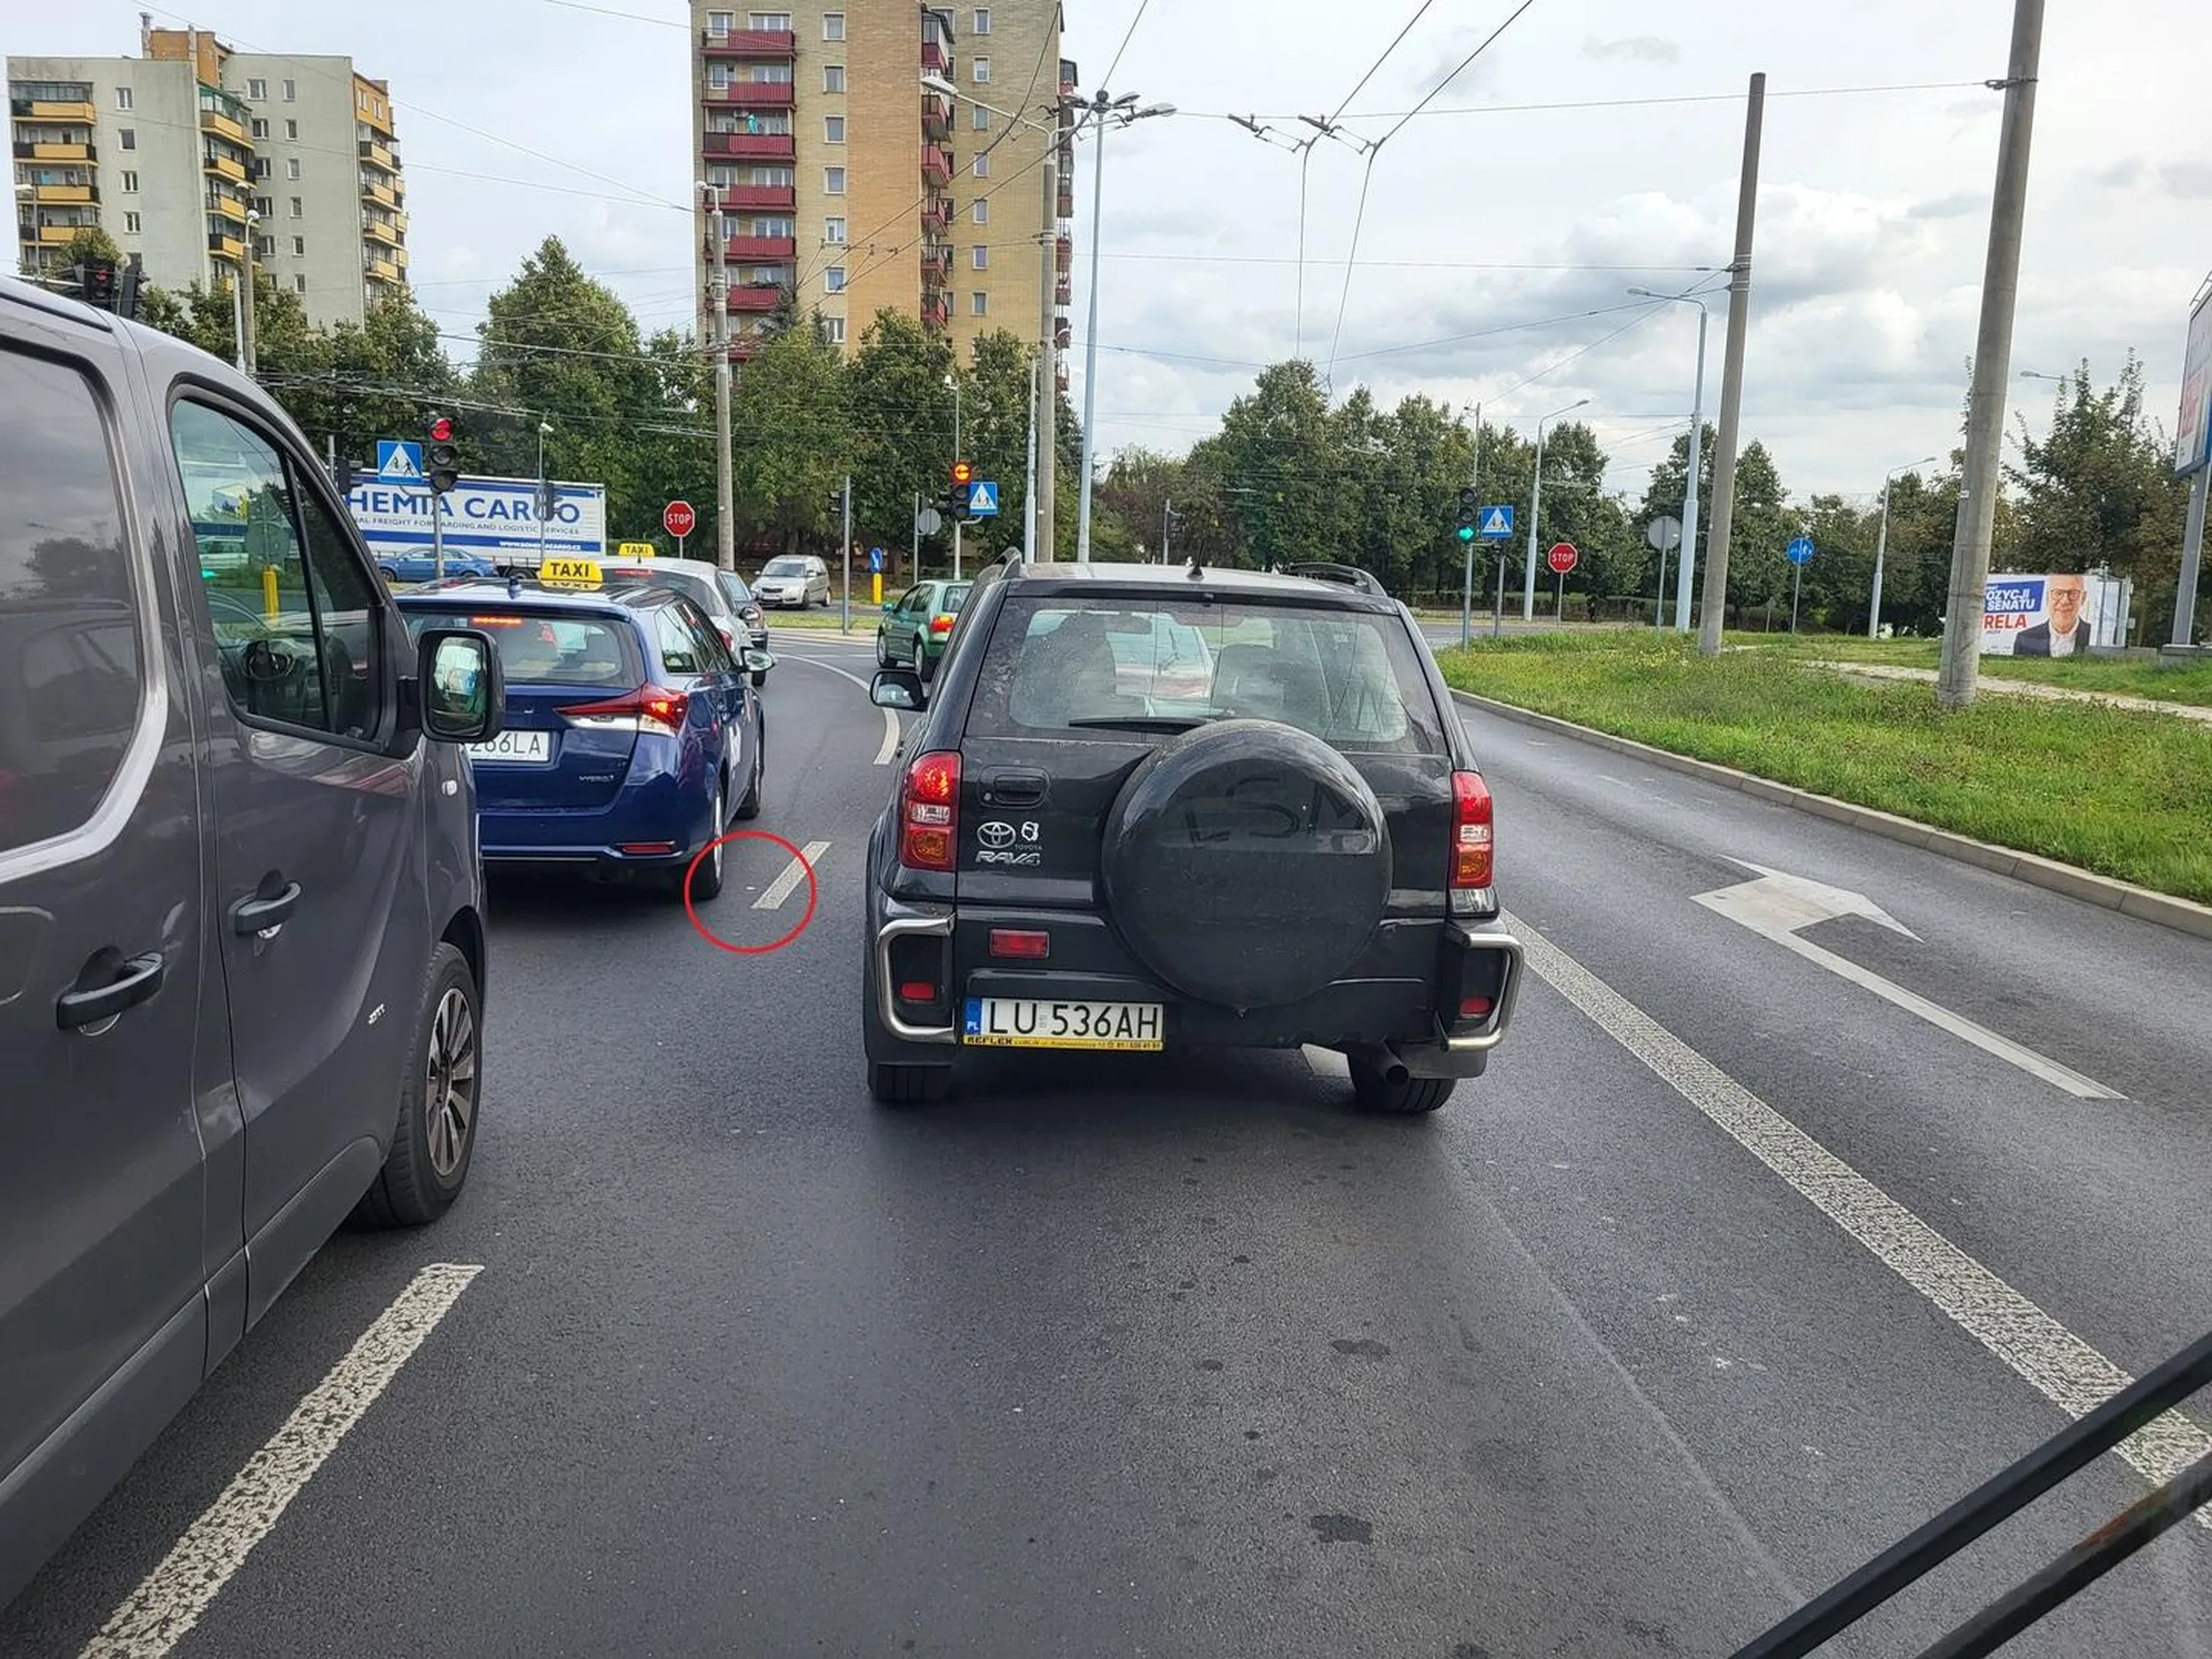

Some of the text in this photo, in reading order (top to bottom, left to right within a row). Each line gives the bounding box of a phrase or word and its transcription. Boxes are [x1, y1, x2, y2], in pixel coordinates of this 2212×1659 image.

[668, 512, 692, 525] STOP
[373, 517, 411, 526] FREIGHT
[413, 519, 475, 530] FORARDING
[476, 522, 496, 531] AND
[545, 526, 580, 536] ERVICES
[626, 545, 649, 555] TAXI
[1551, 553, 1574, 564] STOP
[549, 562, 589, 578] TAXI
[1986, 598, 2035, 611] SENATU
[1984, 614, 2027, 629] RELA
[967, 1021, 979, 1031] PL
[988, 1001, 1158, 1039] LU 536AH
